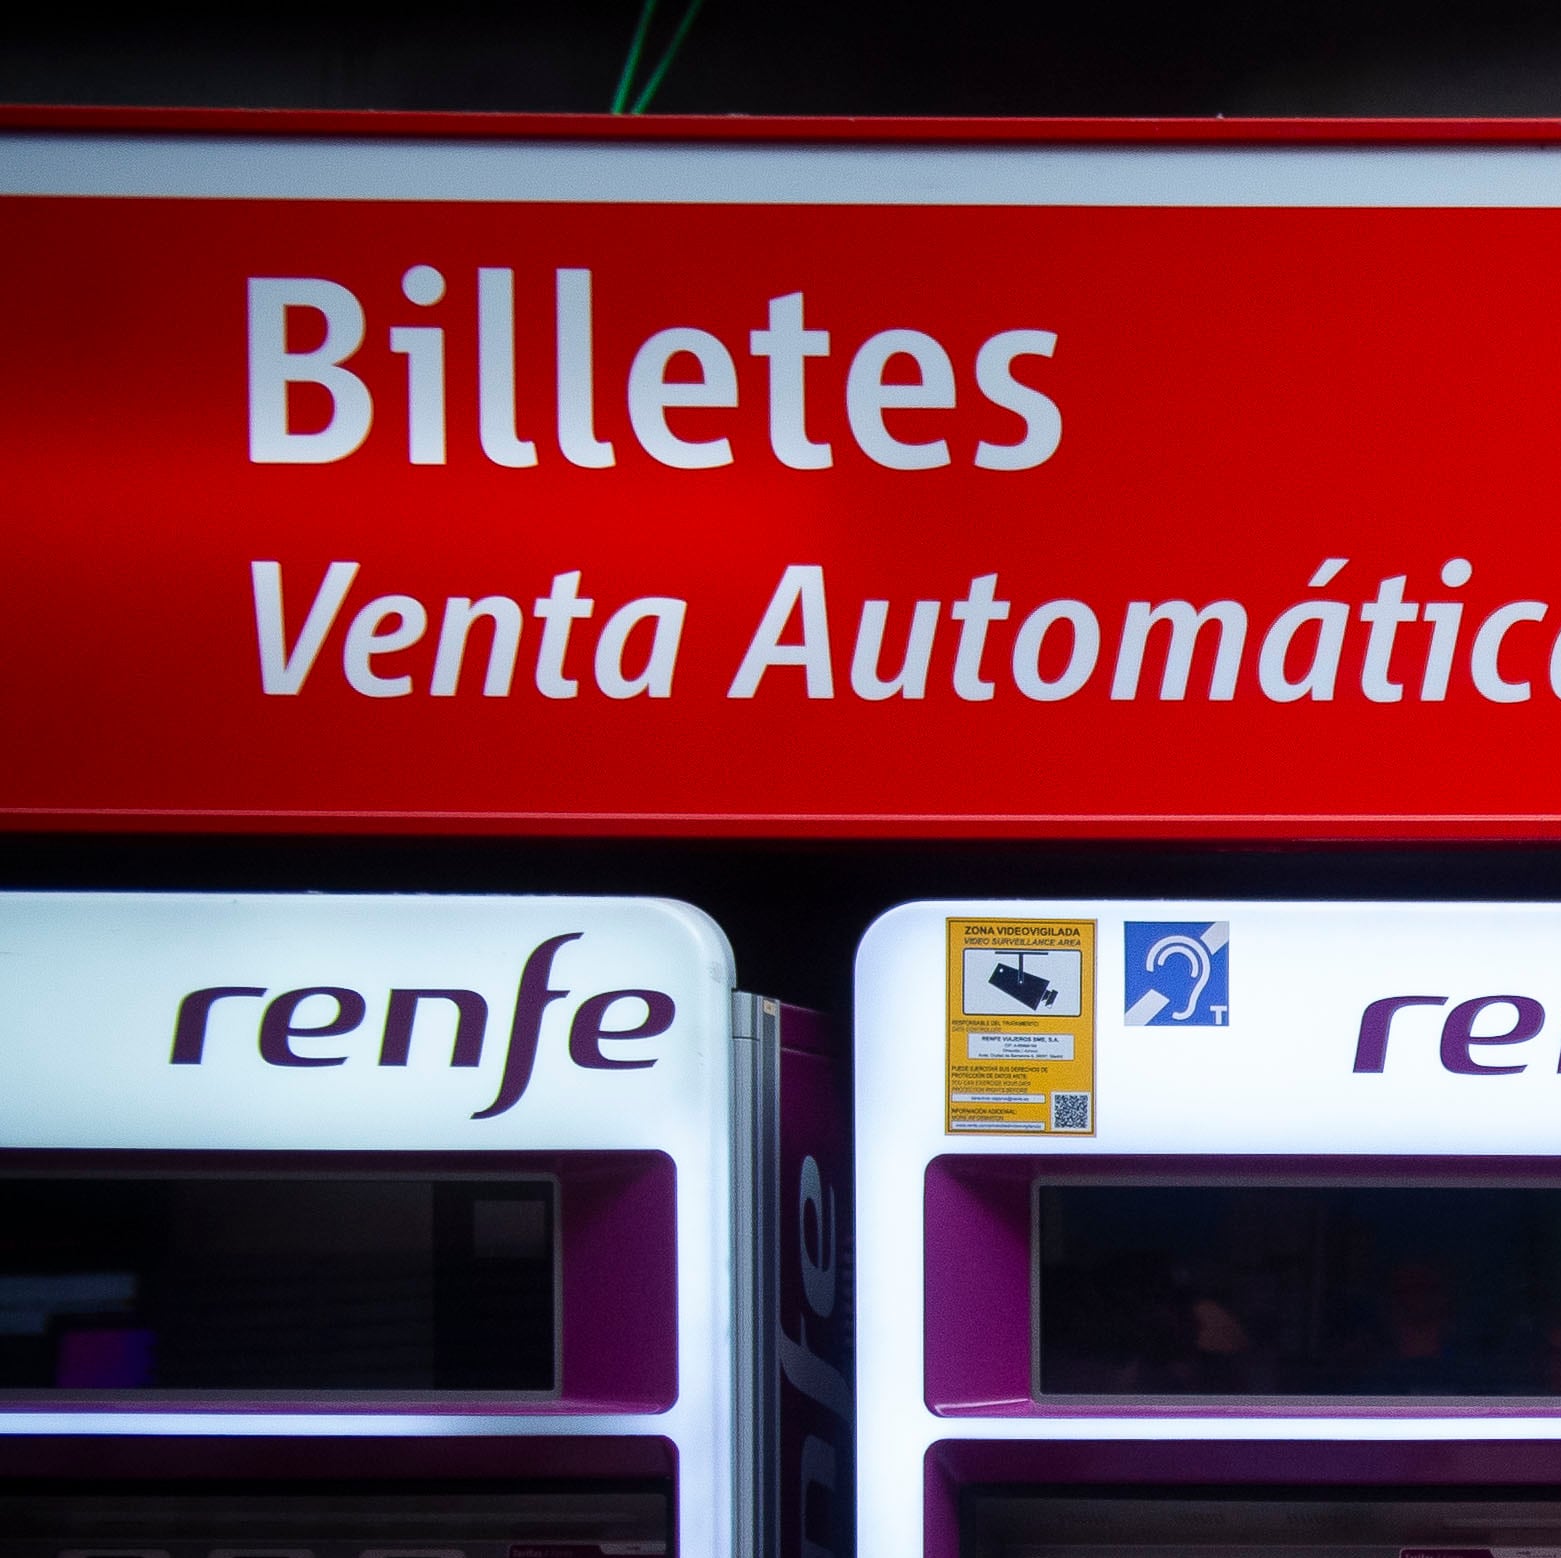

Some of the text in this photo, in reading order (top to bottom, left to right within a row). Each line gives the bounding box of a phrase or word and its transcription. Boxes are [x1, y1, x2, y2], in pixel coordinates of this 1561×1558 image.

[250, 266, 1061, 470] Billetes
[252, 562, 686, 698] Venta
[964, 926, 1080, 936] ZONA VIDEOVIGILADA
[992, 938, 1055, 946] SURVEILLANCE
[1056, 938, 1081, 946] AREA
[172, 933, 675, 1119] renfe
[1210, 1005, 1228, 1025] T
